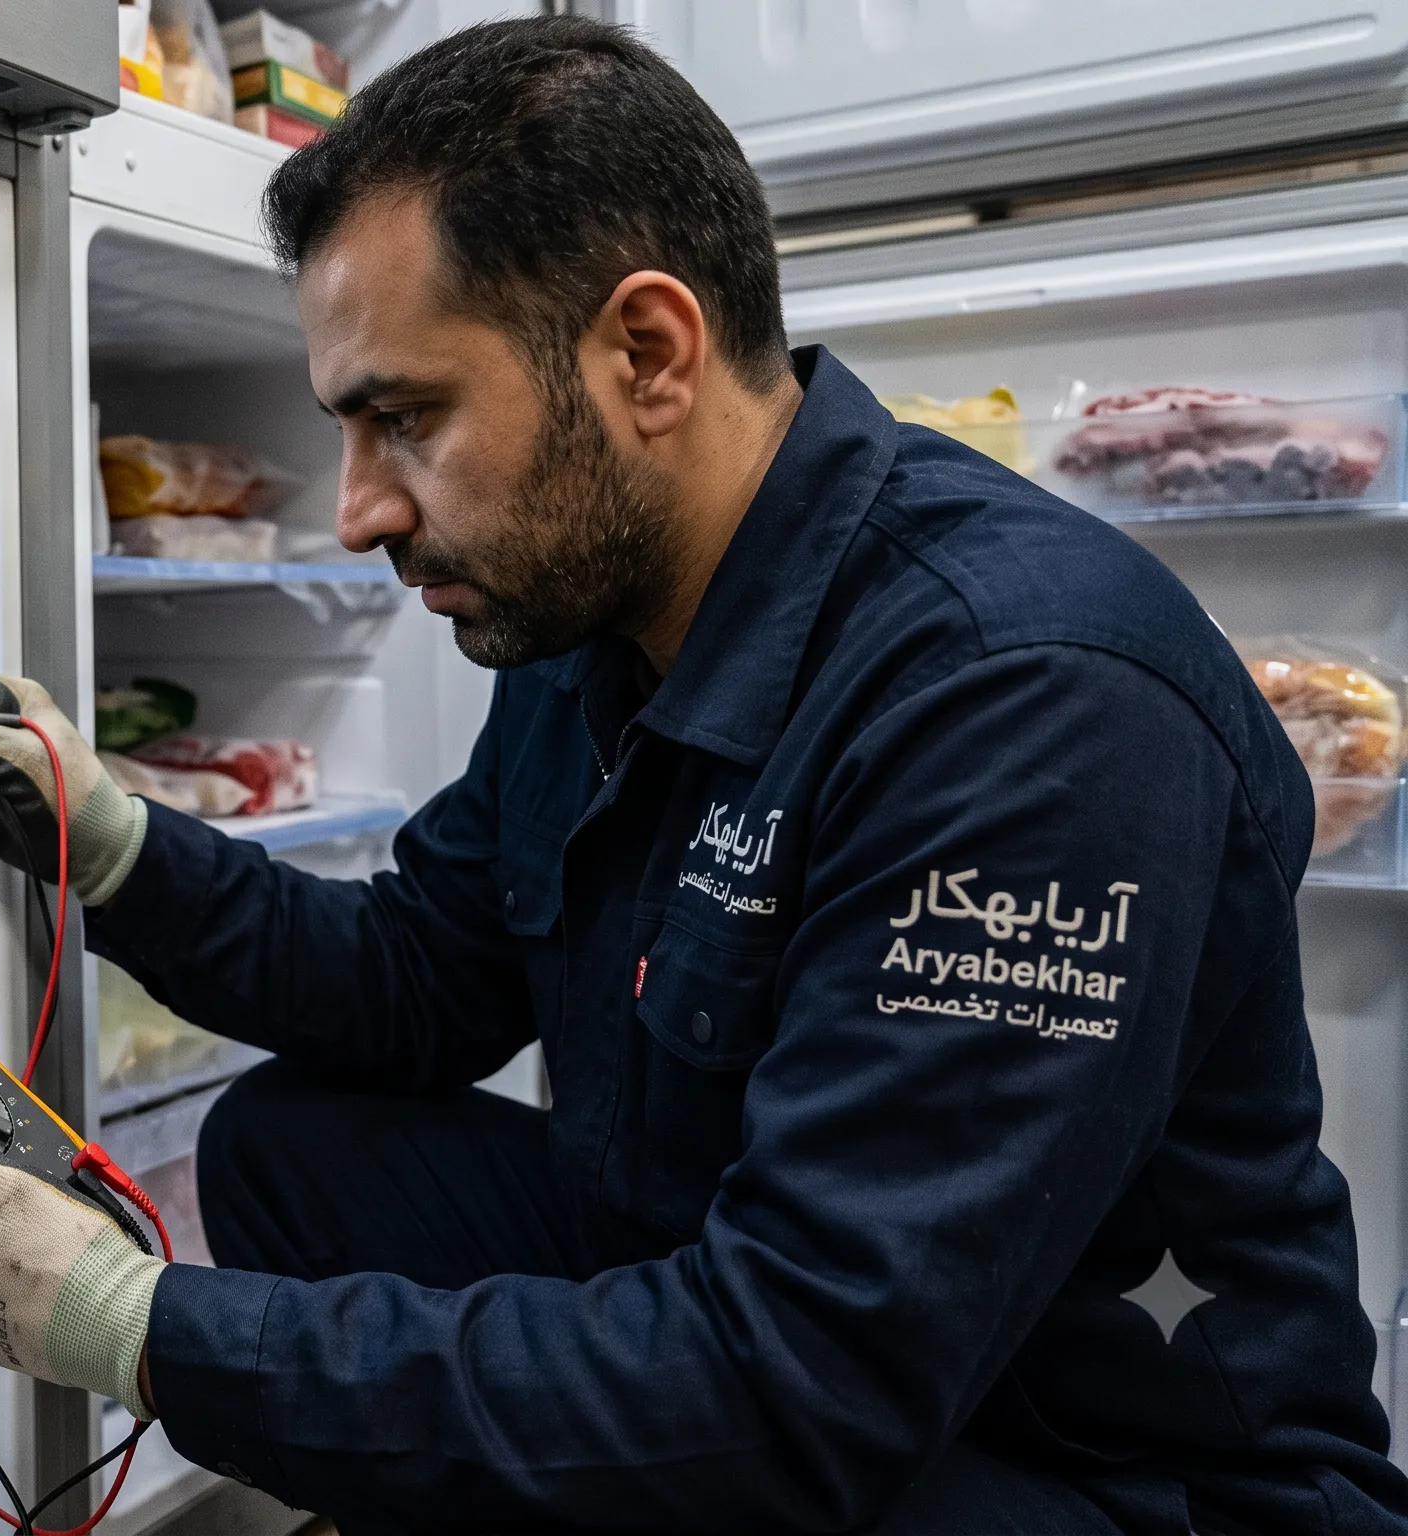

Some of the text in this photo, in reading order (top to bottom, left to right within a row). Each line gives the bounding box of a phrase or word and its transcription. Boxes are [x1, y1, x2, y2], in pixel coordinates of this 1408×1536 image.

[688, 801, 784, 875] آریابهکار
[712, 881, 777, 915] تعمیرات
[889, 868, 1141, 952] آریابهکار
[880, 937, 1127, 1002] Aryabekhar
[876, 993, 1119, 1041] تعمیرات تخصصی
